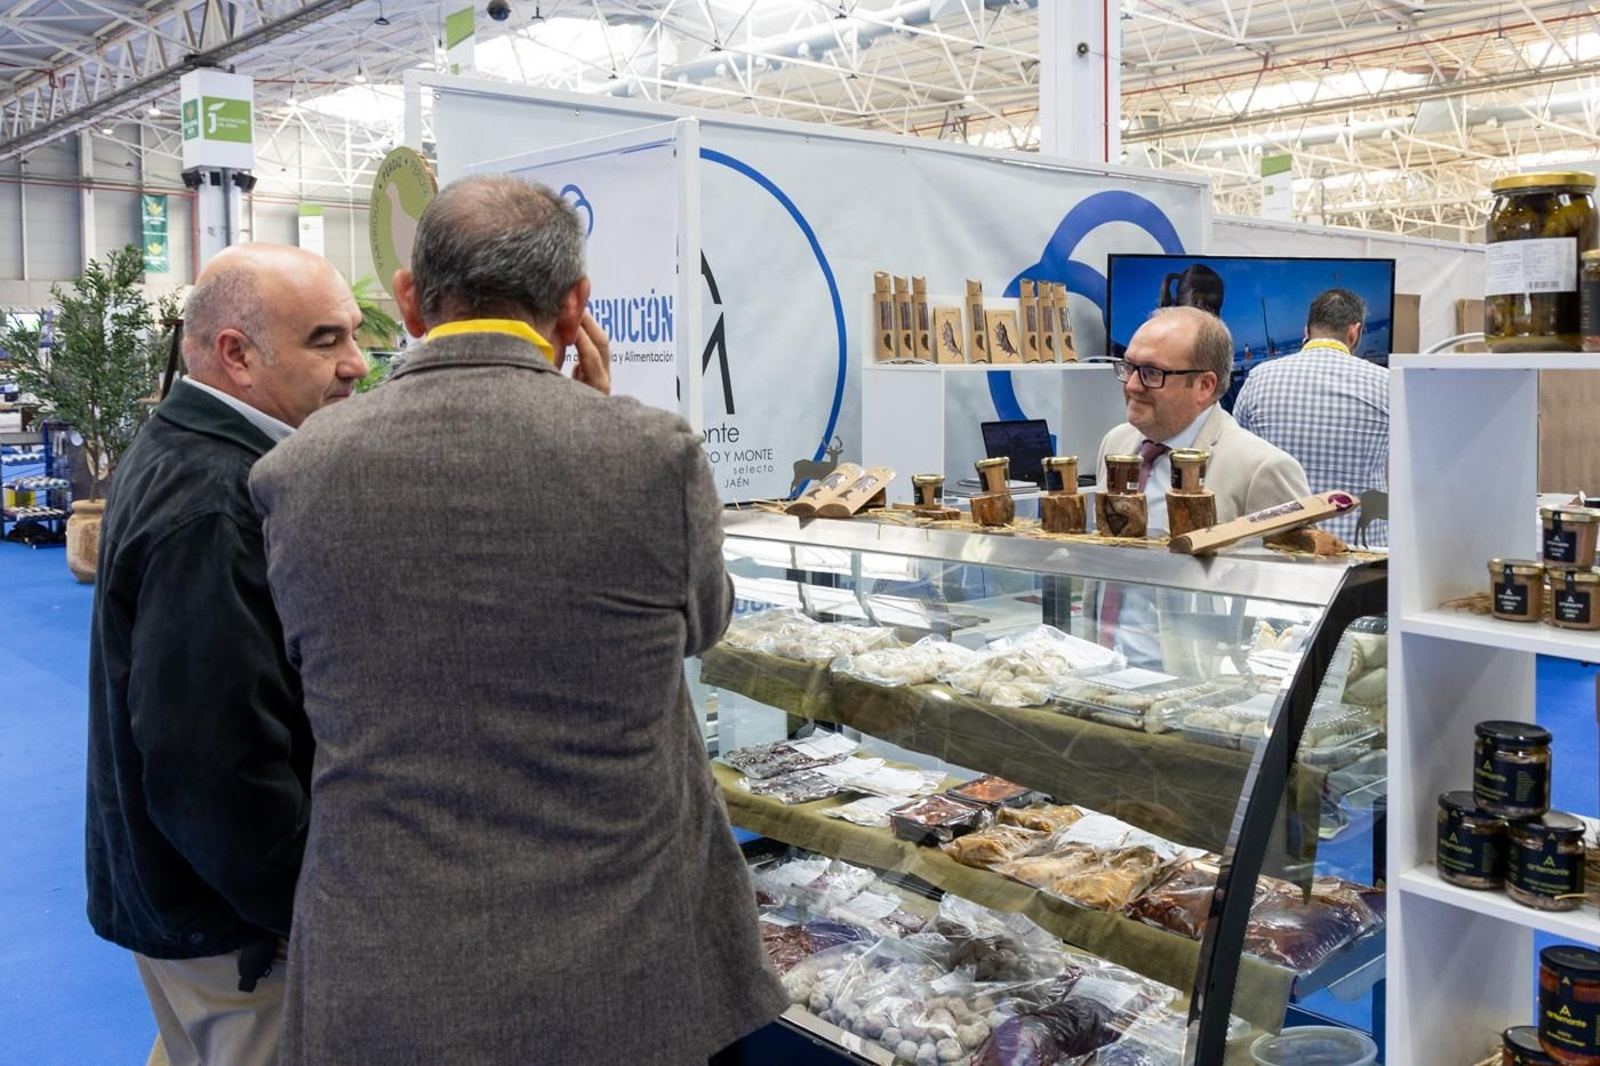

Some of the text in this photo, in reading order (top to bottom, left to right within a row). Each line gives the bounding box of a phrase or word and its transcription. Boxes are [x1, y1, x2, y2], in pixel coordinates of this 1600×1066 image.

[625, 350, 673, 363] Alimentación
[734, 448, 774, 462] MONTE
[733, 464, 774, 475] selecto
[724, 475, 750, 488] JAÉN
[1527, 863, 1570, 876] artemonte
